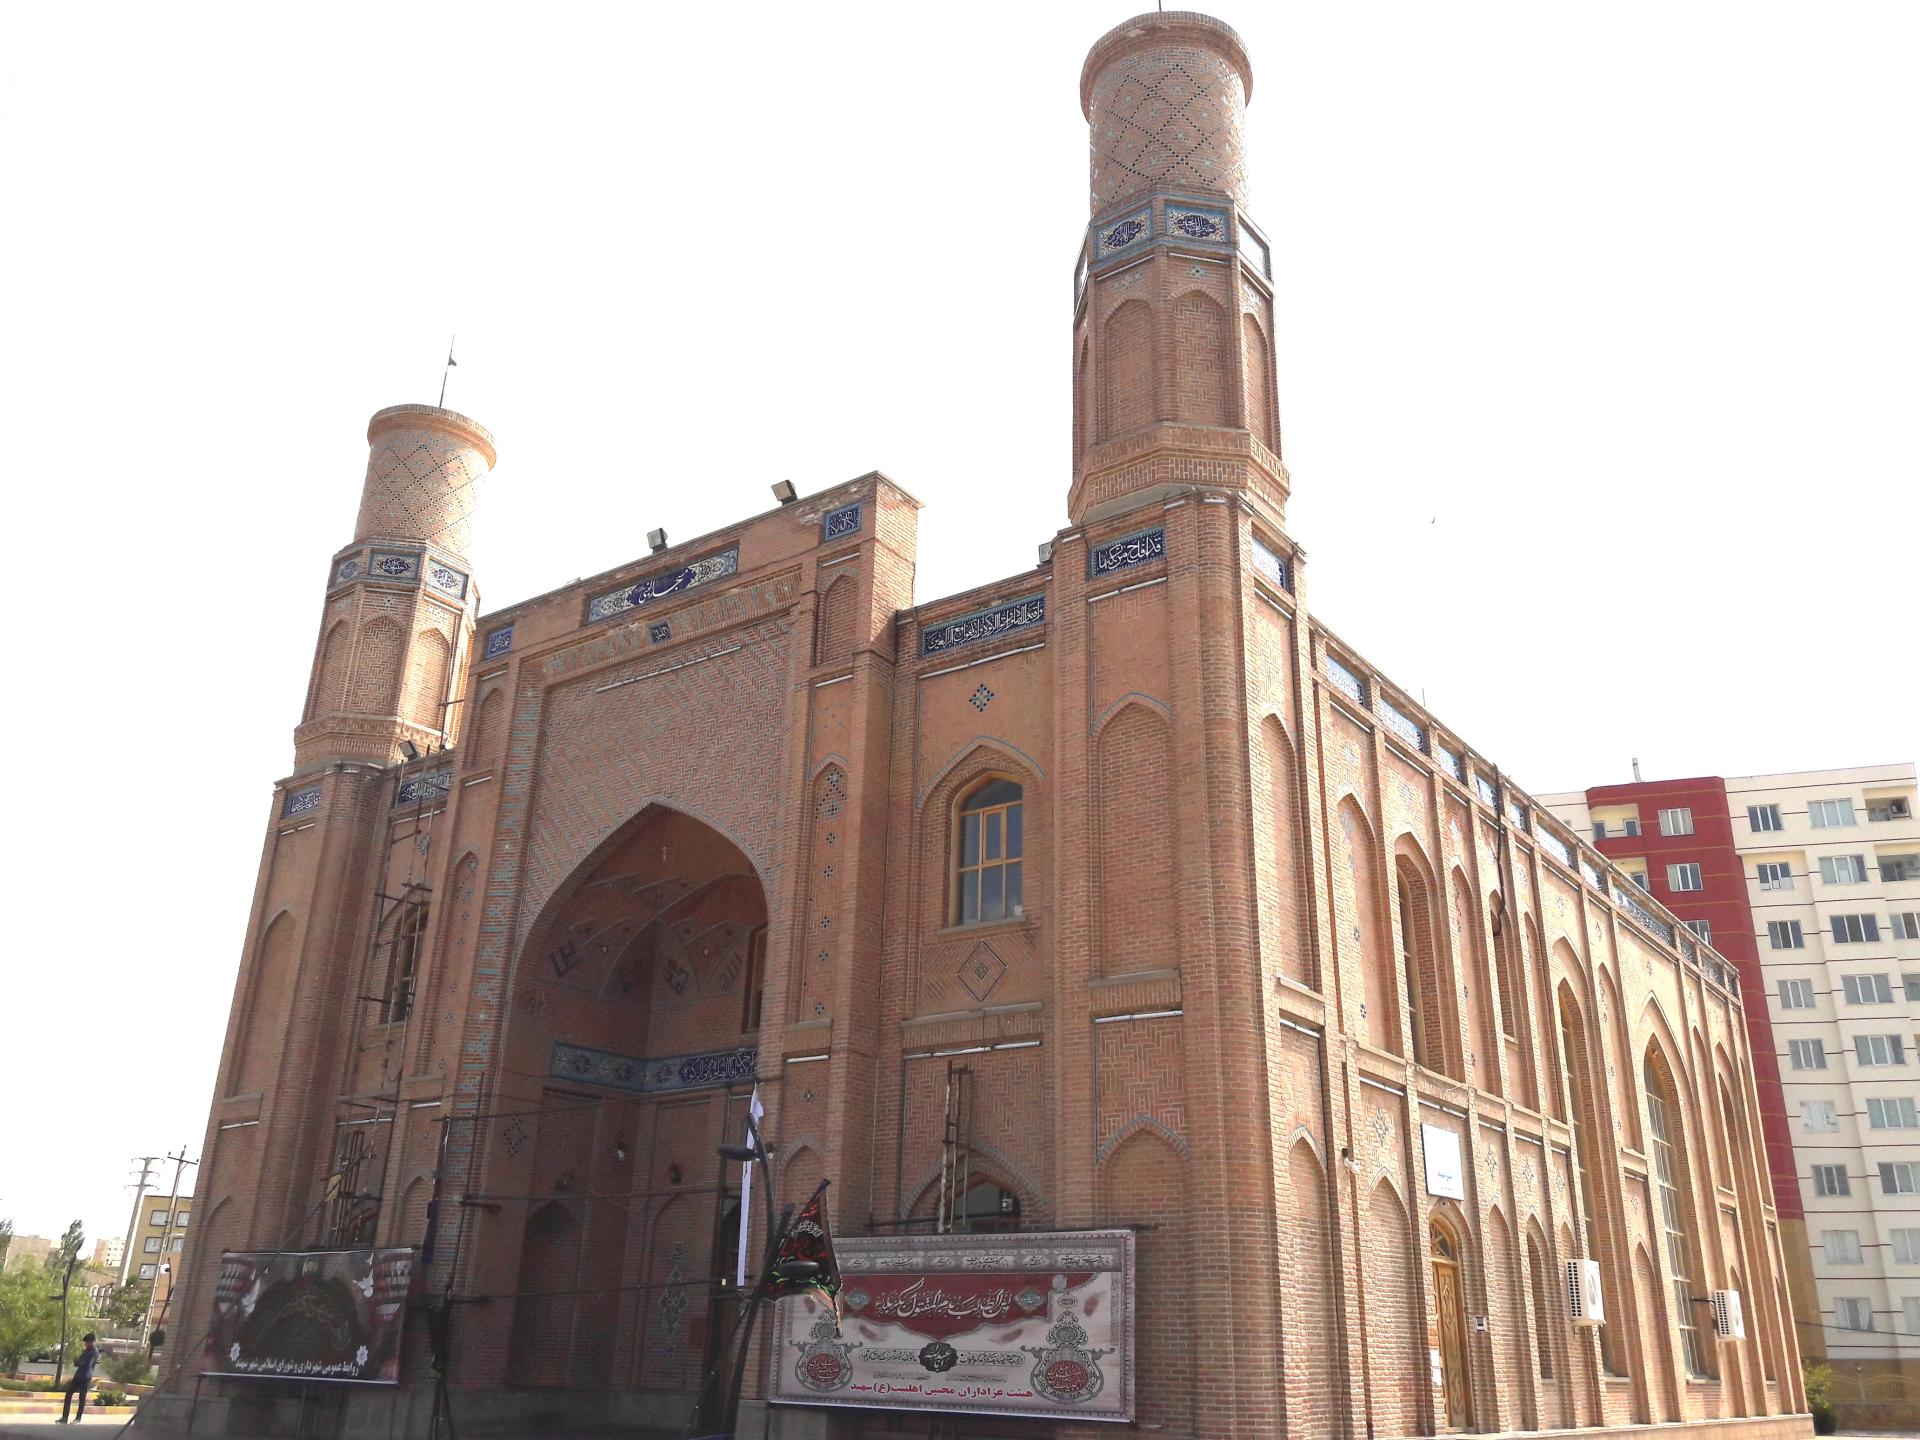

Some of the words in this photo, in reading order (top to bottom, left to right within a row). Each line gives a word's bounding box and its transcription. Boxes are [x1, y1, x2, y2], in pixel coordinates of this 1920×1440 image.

[652, 568, 689, 598] مسجد
[298, 1360, 322, 1374] شهرداری
[322, 1361, 341, 1374] عمومی
[342, 1361, 359, 1376] روابط
[958, 1387, 1003, 1398] عزاداران
